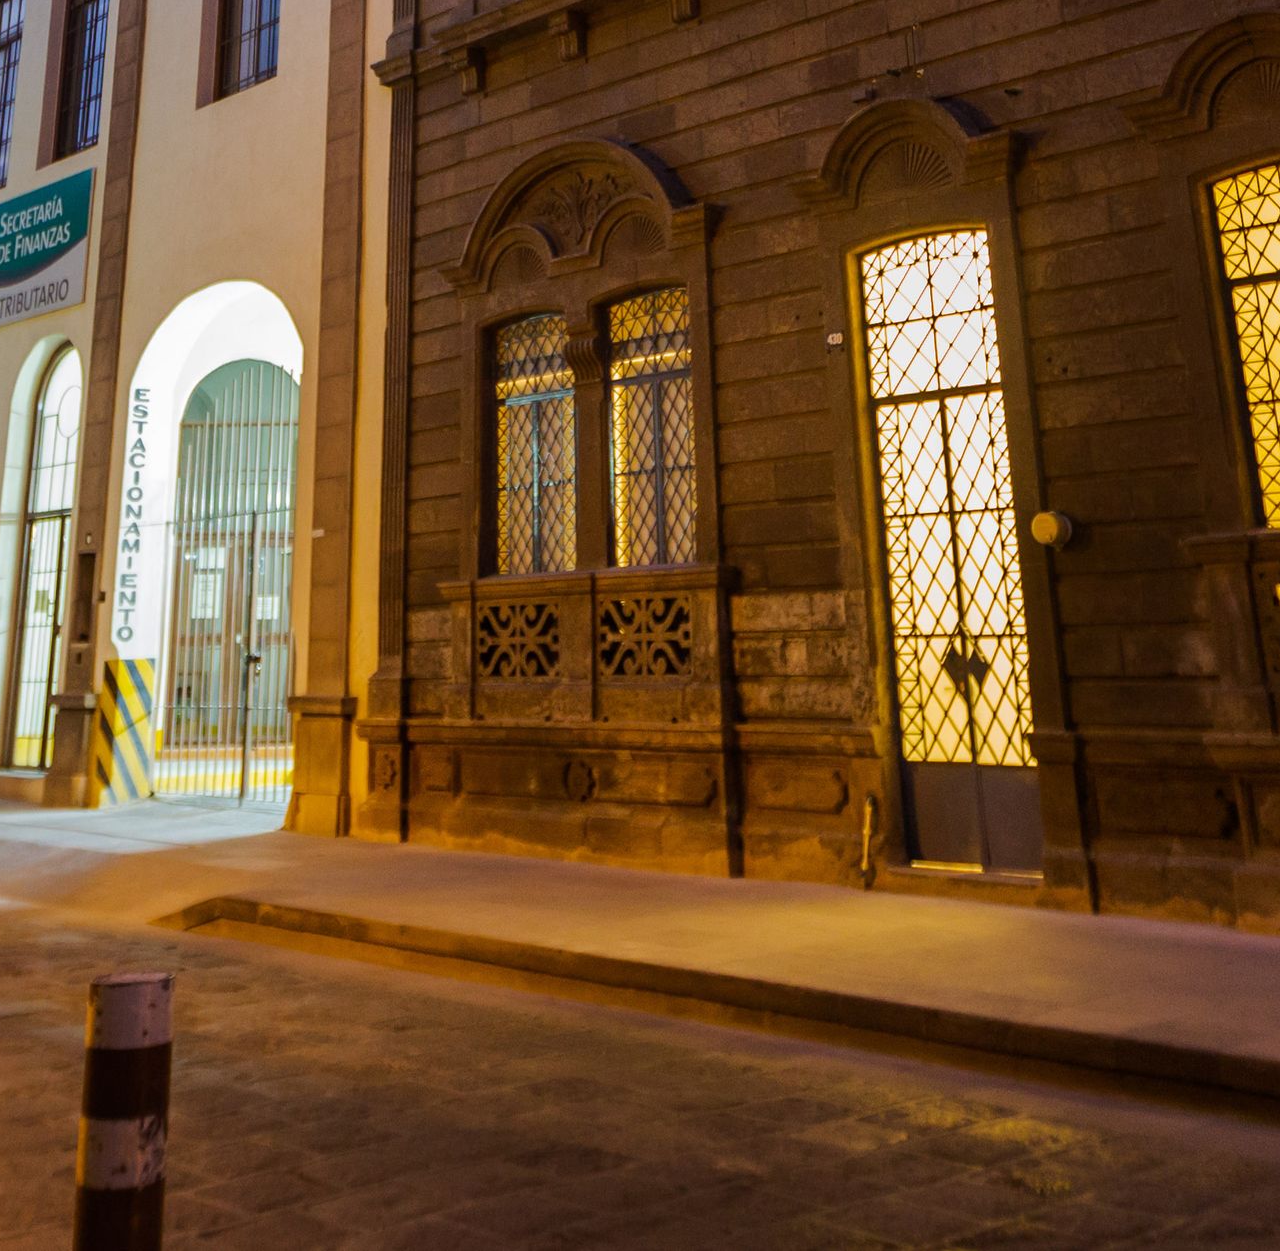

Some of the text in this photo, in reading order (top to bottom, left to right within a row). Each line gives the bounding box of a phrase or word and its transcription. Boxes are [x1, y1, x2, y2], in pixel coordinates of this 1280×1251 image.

[0, 194, 63, 238] SECRETARÍA
[14, 221, 71, 260] FINANZAS
[0, 278, 69, 318] TRIBUTARIO
[116, 388, 151, 642] ESTACIONAMIENTO
